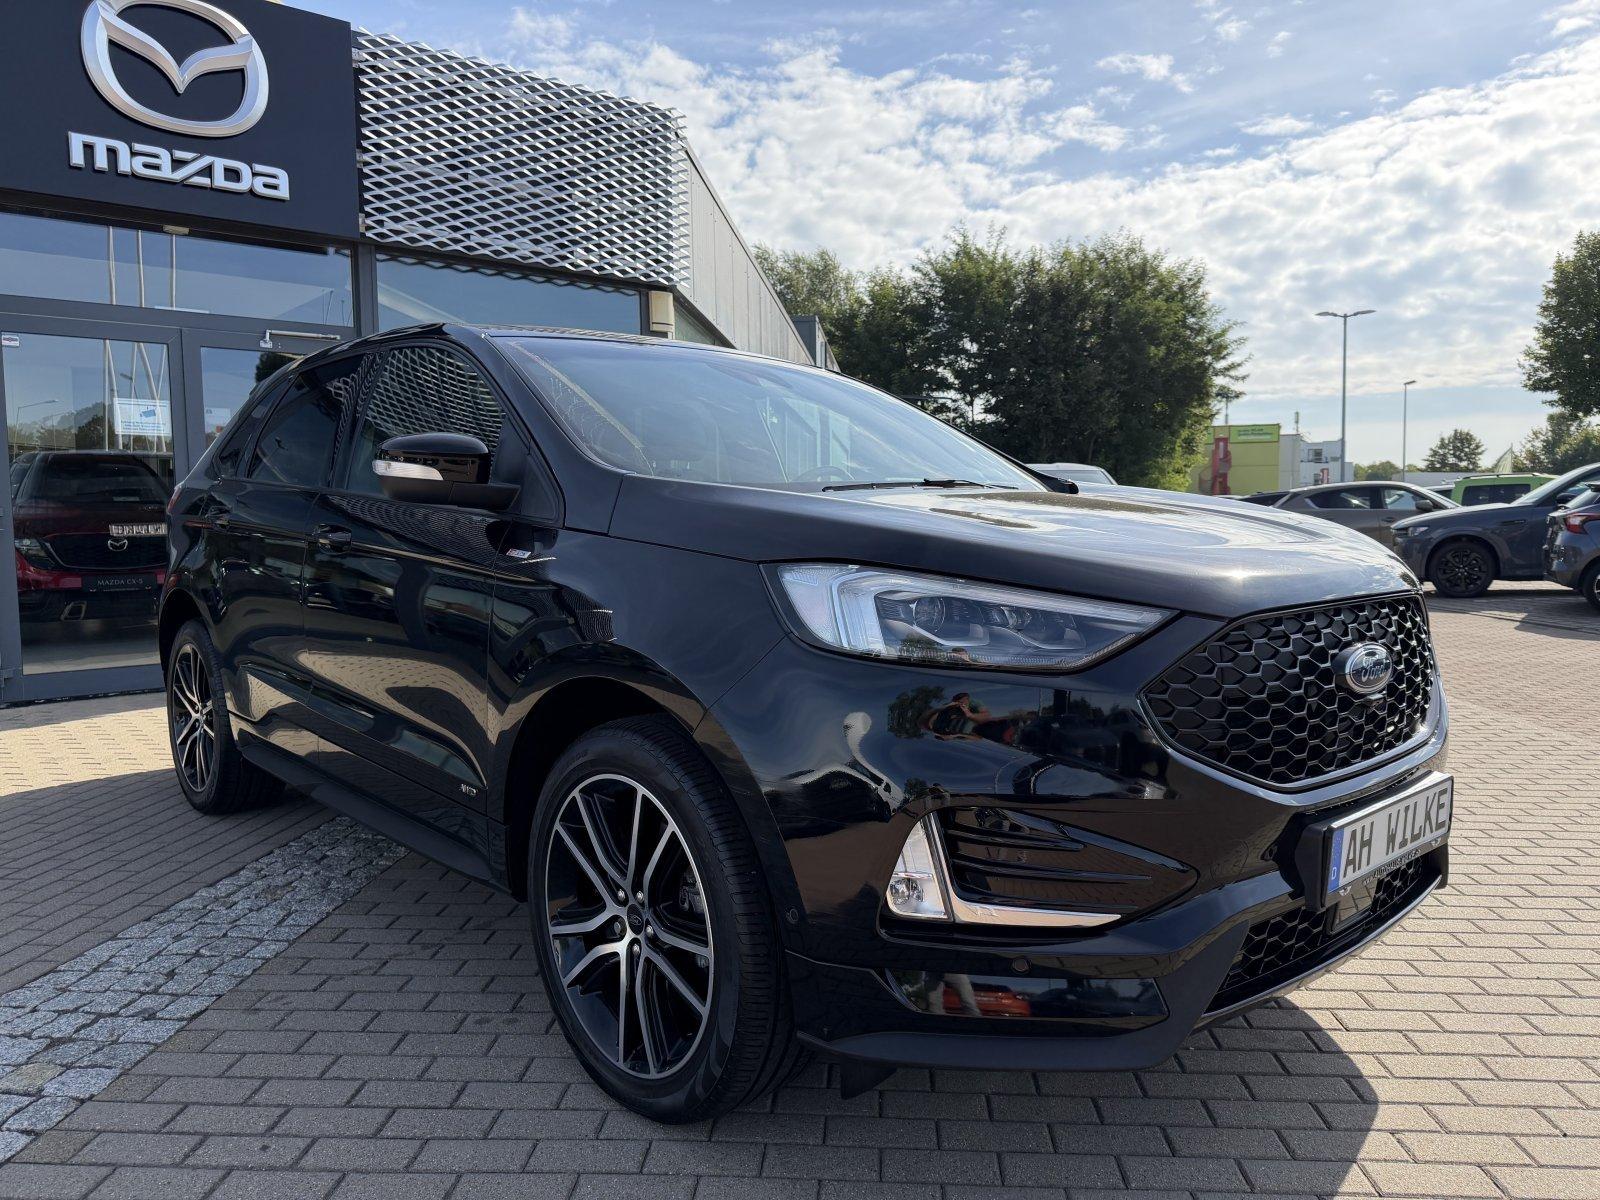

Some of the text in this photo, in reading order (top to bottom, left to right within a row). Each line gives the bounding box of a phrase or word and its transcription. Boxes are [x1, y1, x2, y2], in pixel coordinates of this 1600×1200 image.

[1361, 657, 1388, 683] Ford
[1331, 866, 1337, 880] D
[1343, 820, 1375, 879] AH
[1385, 787, 1448, 856] WILKE
